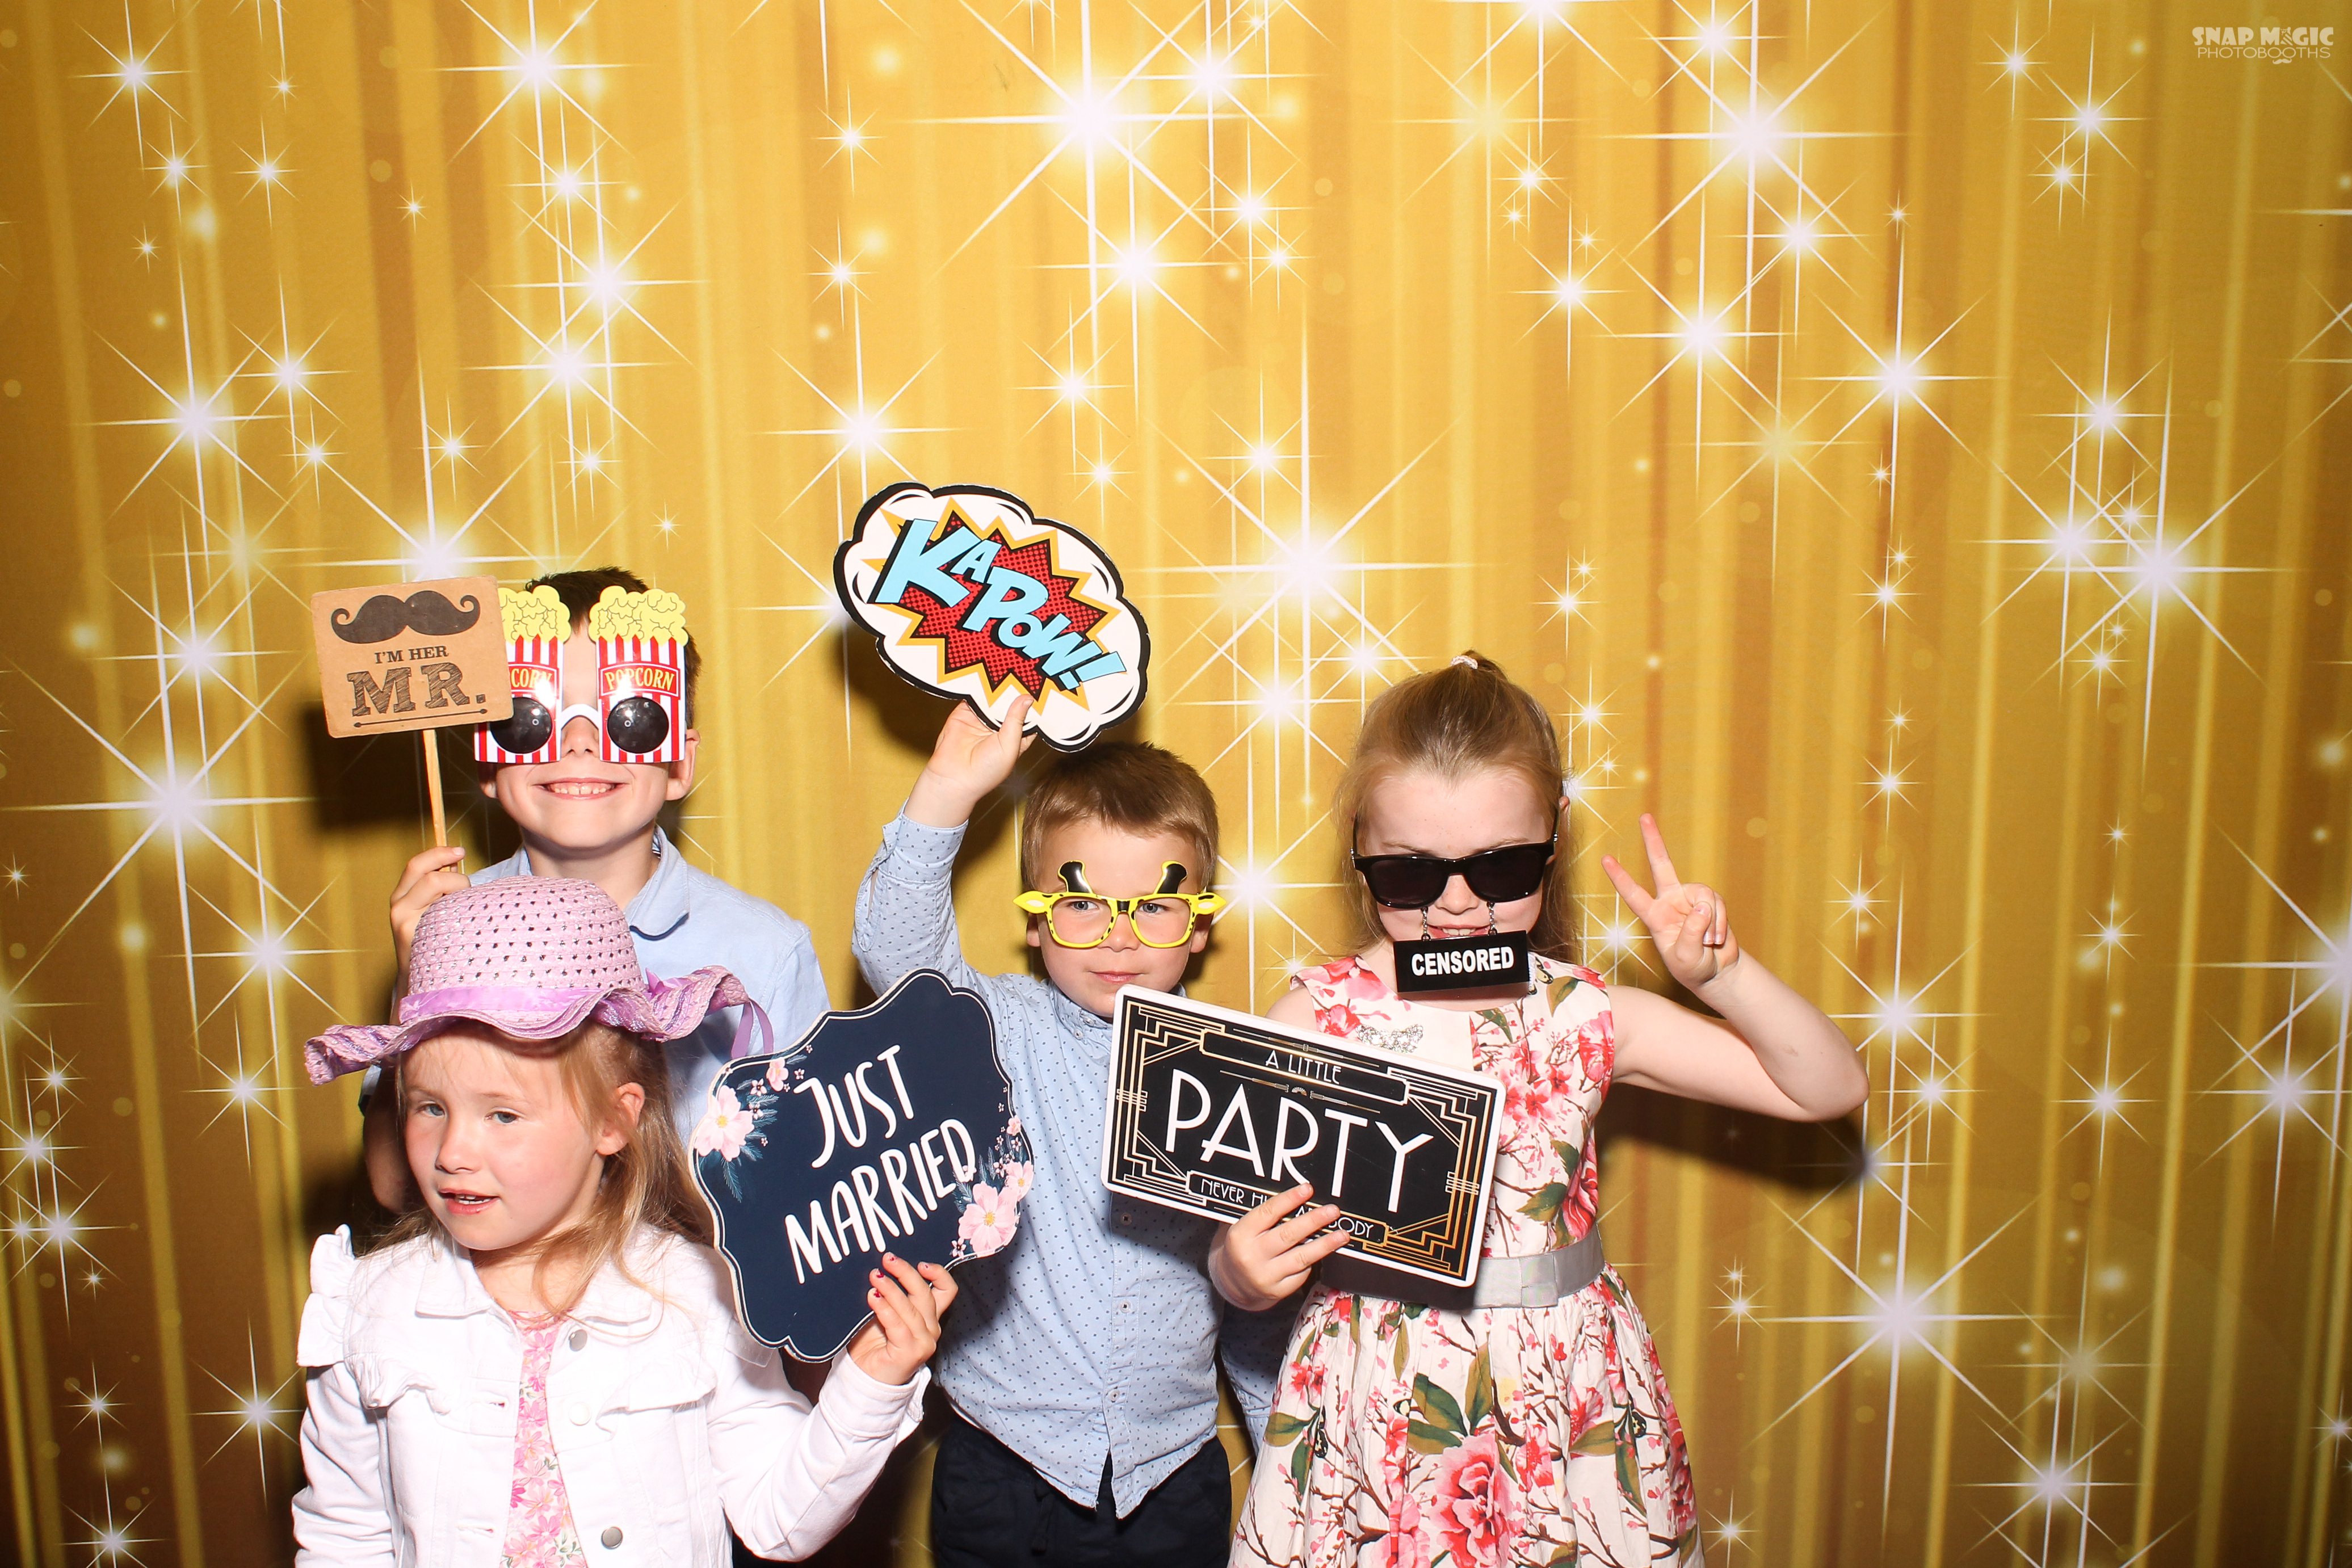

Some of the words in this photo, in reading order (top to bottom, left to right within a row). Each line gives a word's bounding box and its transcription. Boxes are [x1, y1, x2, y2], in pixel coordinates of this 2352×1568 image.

[872, 518, 1127, 691] KAPOW!
[375, 650, 404, 664] I'M
[408, 645, 449, 660] HER
[347, 662, 486, 717] MR.
[511, 668, 552, 688] CORN
[1411, 946, 1514, 977] CENSORED
[1265, 1050, 1279, 1069] A
[1288, 1054, 1342, 1084] LITTLE
[793, 1045, 914, 1168] JUST
[1165, 1069, 1434, 1213] PARTY
[785, 1119, 975, 1283] MARRIED
[1201, 1178, 1244, 1204] NEVER
